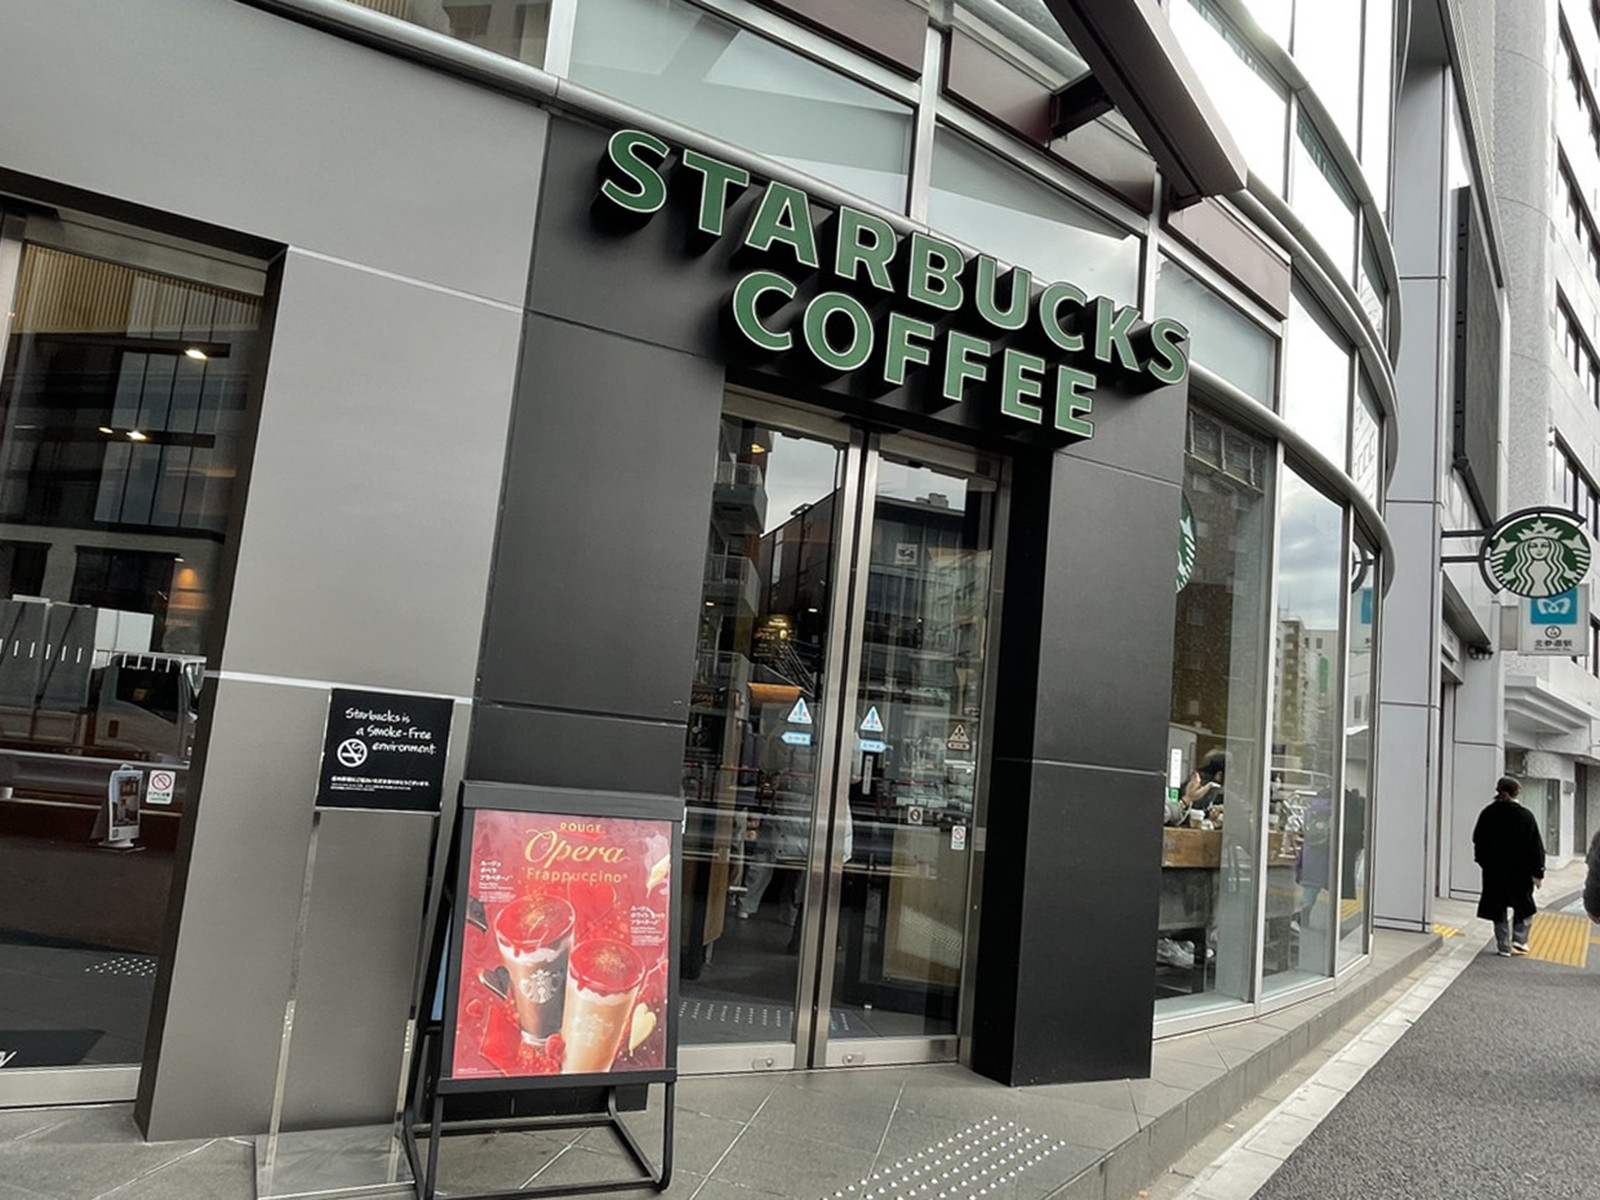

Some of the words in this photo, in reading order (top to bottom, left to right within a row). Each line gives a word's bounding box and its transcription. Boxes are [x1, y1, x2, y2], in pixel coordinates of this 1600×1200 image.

[601, 129, 1190, 385] STARBUCKS
[732, 270, 1097, 439] COFFEE
[345, 707, 401, 723] Starbucks
[401, 711, 411, 724] is
[355, 727, 365, 736] a
[560, 822, 603, 834] ROUGE
[525, 827, 632, 869] Opera
